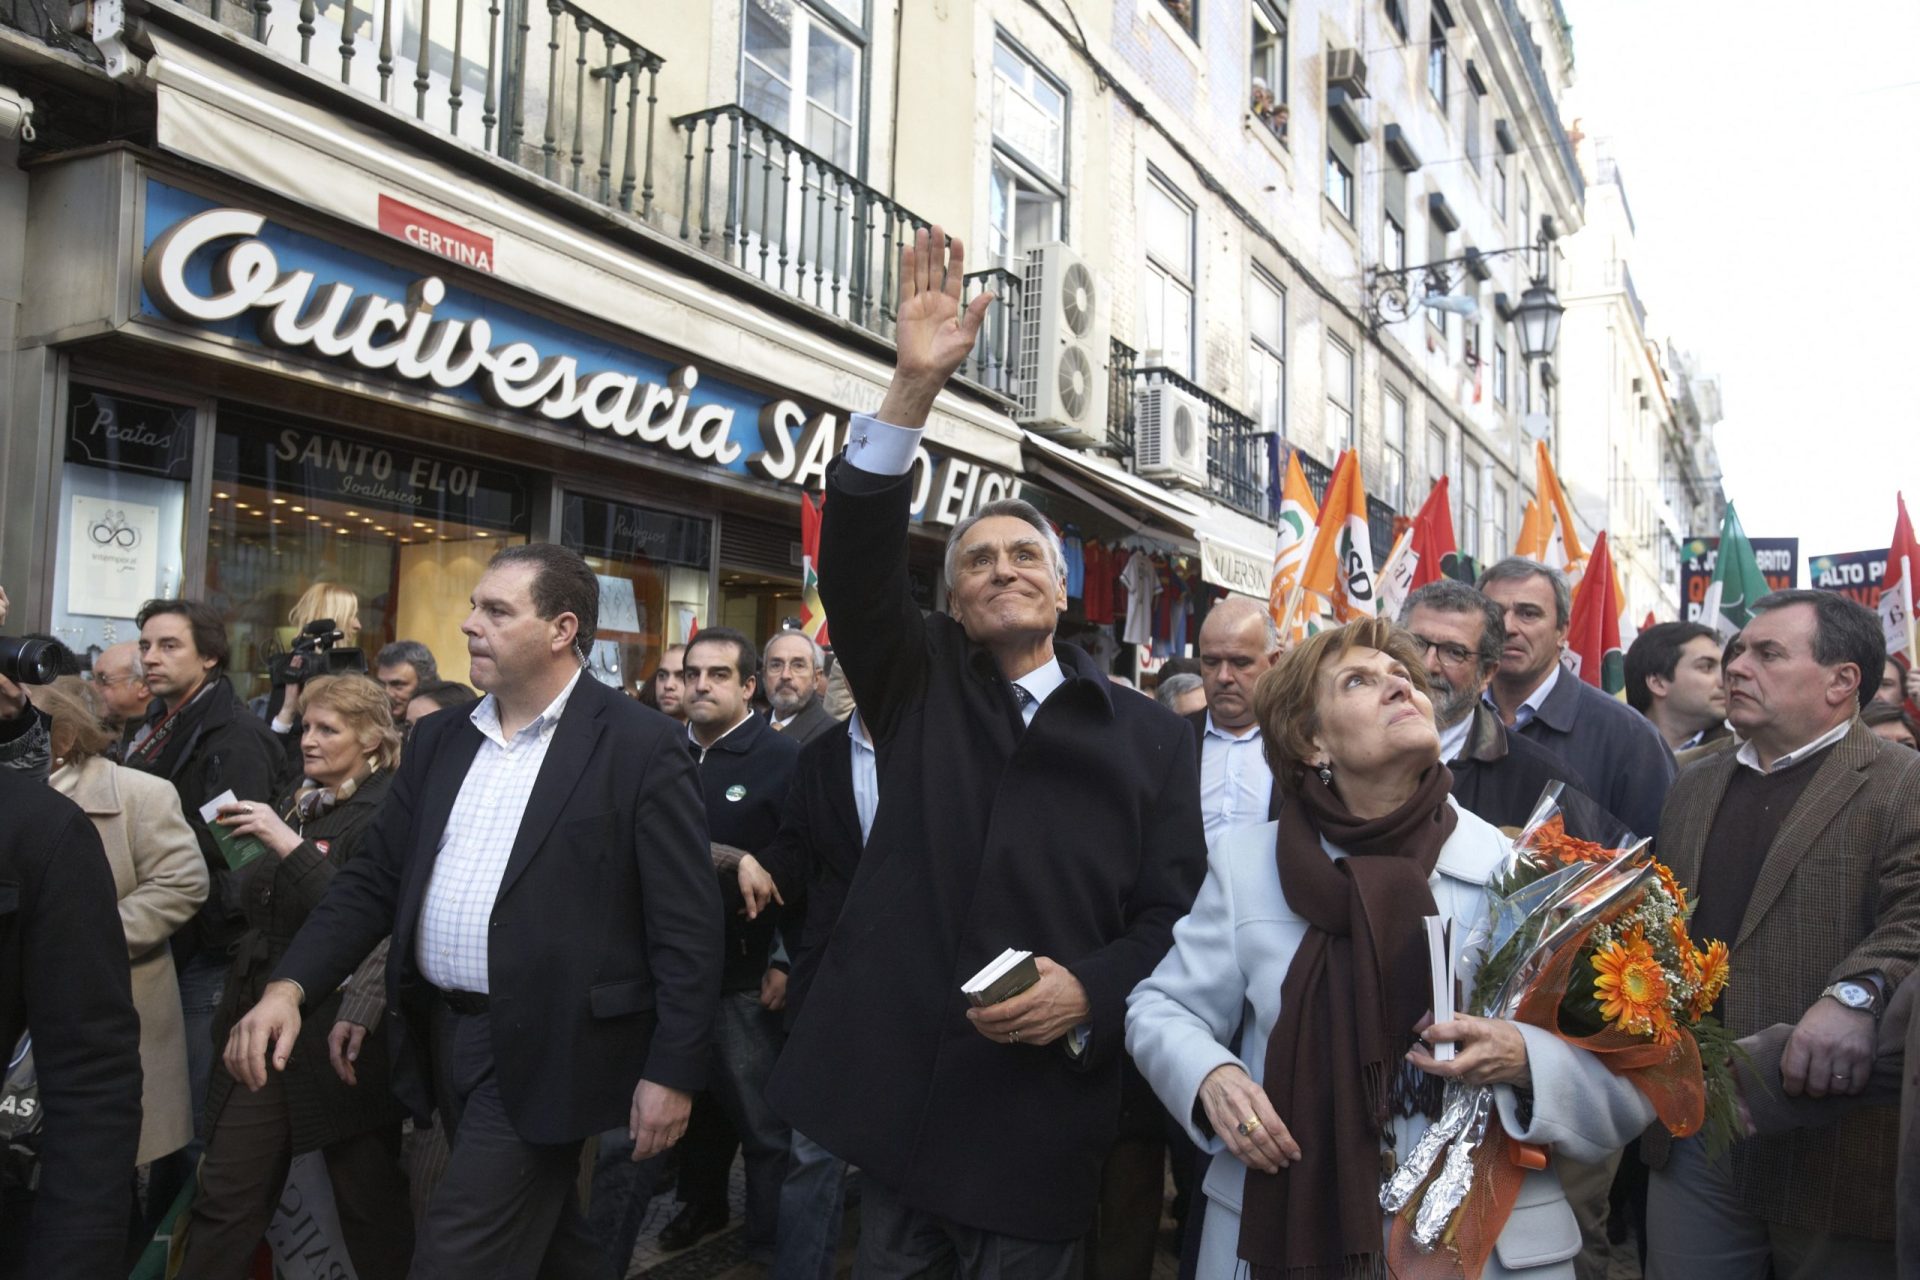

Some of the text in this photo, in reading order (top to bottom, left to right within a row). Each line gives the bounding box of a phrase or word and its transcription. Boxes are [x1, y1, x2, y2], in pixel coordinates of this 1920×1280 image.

[404, 223, 491, 272] CERTINA
[154, 207, 743, 464] Ourivesaria
[275, 429, 480, 499] SANTO ELOI
[1819, 563, 1865, 587] ALTO
